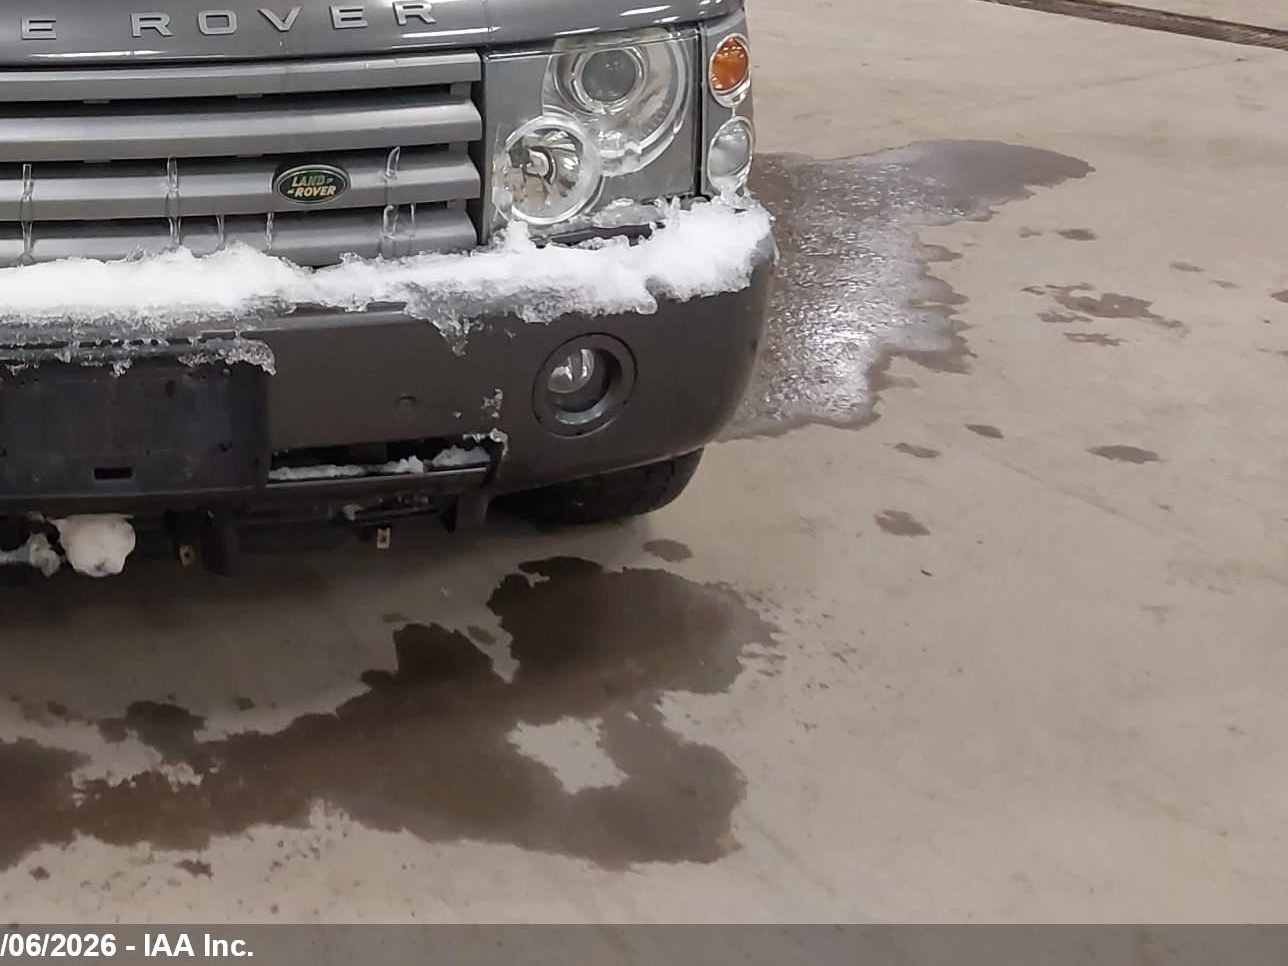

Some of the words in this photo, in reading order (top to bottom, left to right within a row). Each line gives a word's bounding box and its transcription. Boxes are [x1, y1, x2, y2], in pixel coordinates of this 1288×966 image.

[130, 0, 438, 38] ROVER
[292, 175, 326, 187] LAND
[294, 185, 337, 197] ROVER
